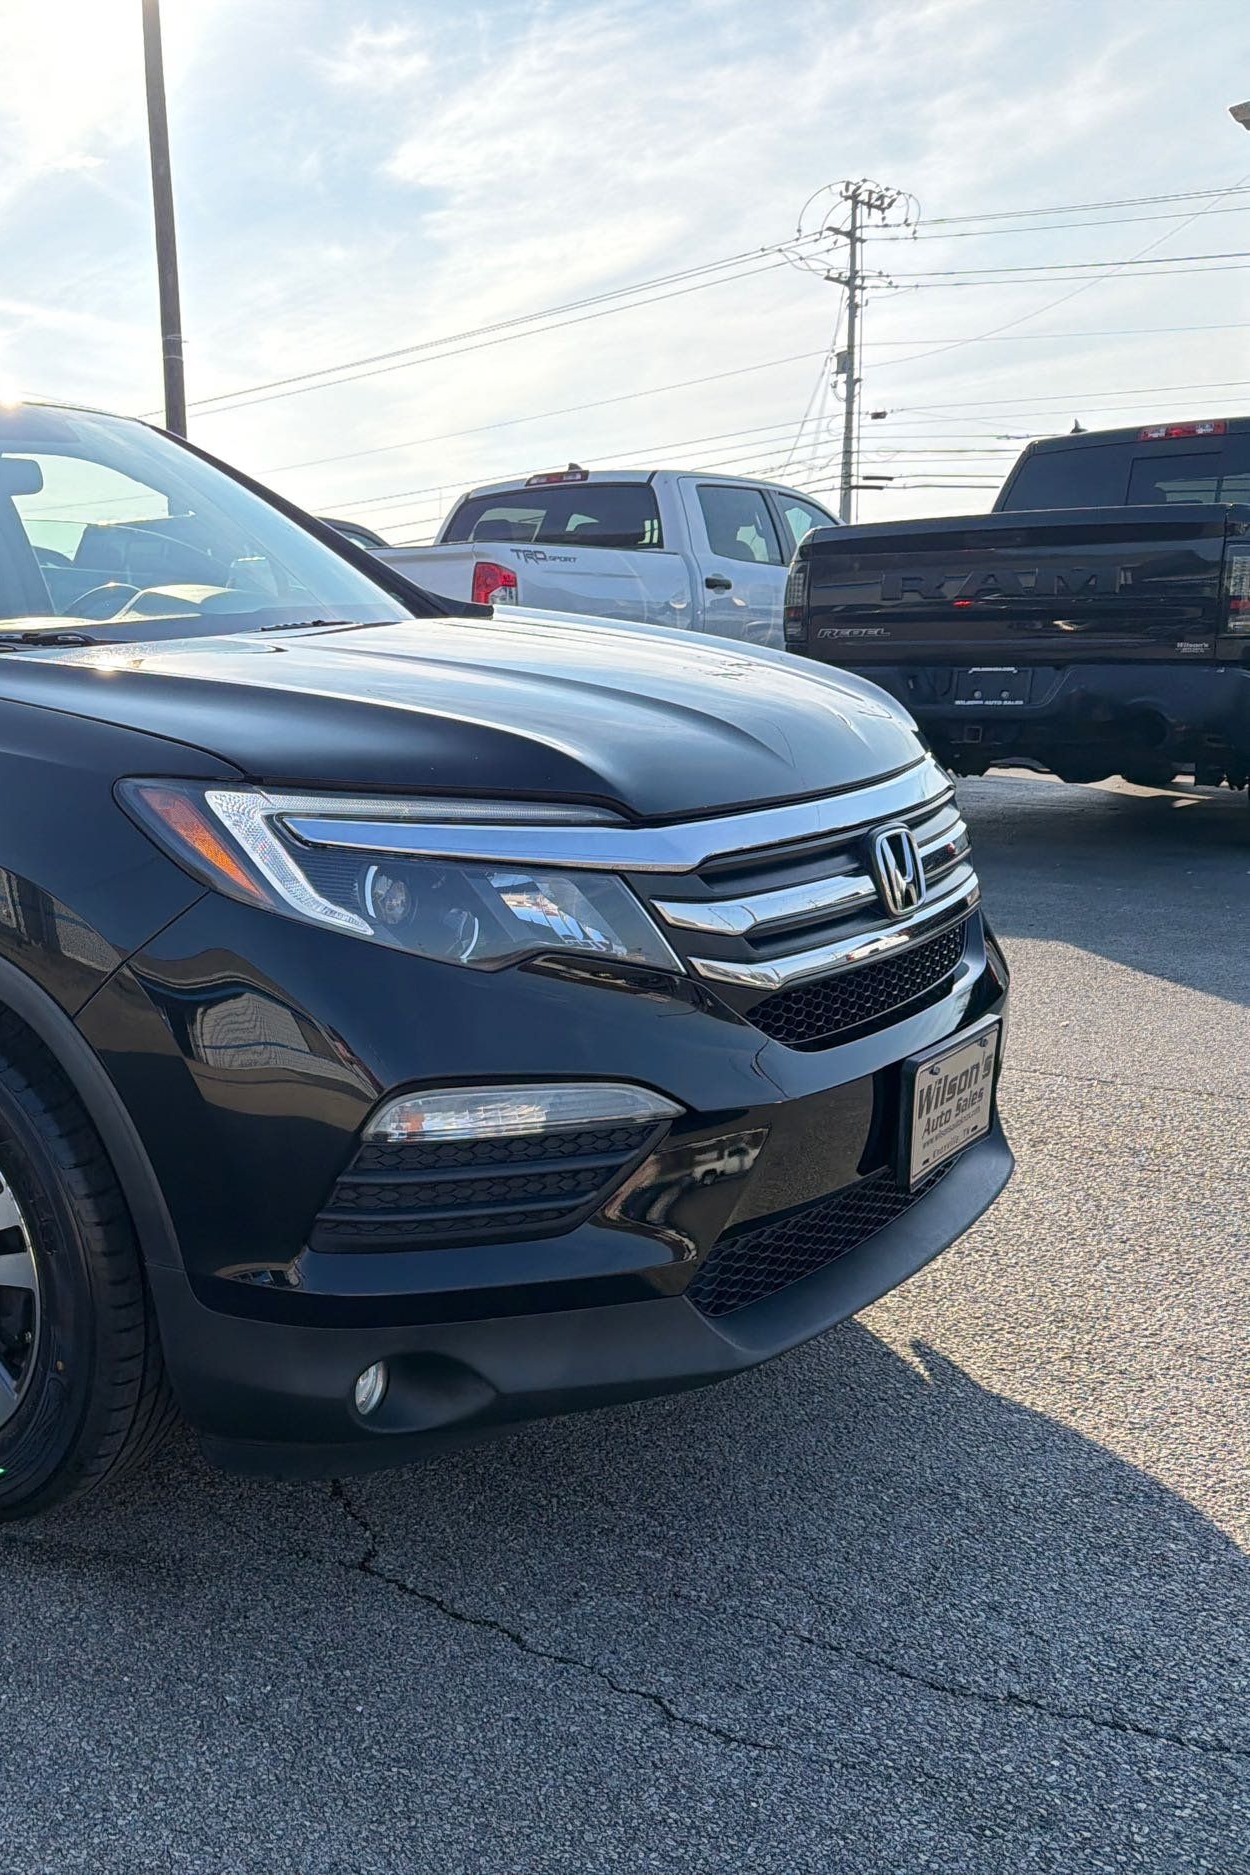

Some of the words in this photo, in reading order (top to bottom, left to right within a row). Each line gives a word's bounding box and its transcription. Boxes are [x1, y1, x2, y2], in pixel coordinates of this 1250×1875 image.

[510, 548, 547, 565] TRD
[880, 565, 1120, 601] RAM
[917, 1052, 993, 1120] Wilson's
[922, 1108, 952, 1139] Auto
[954, 1087, 984, 1118] Sales
